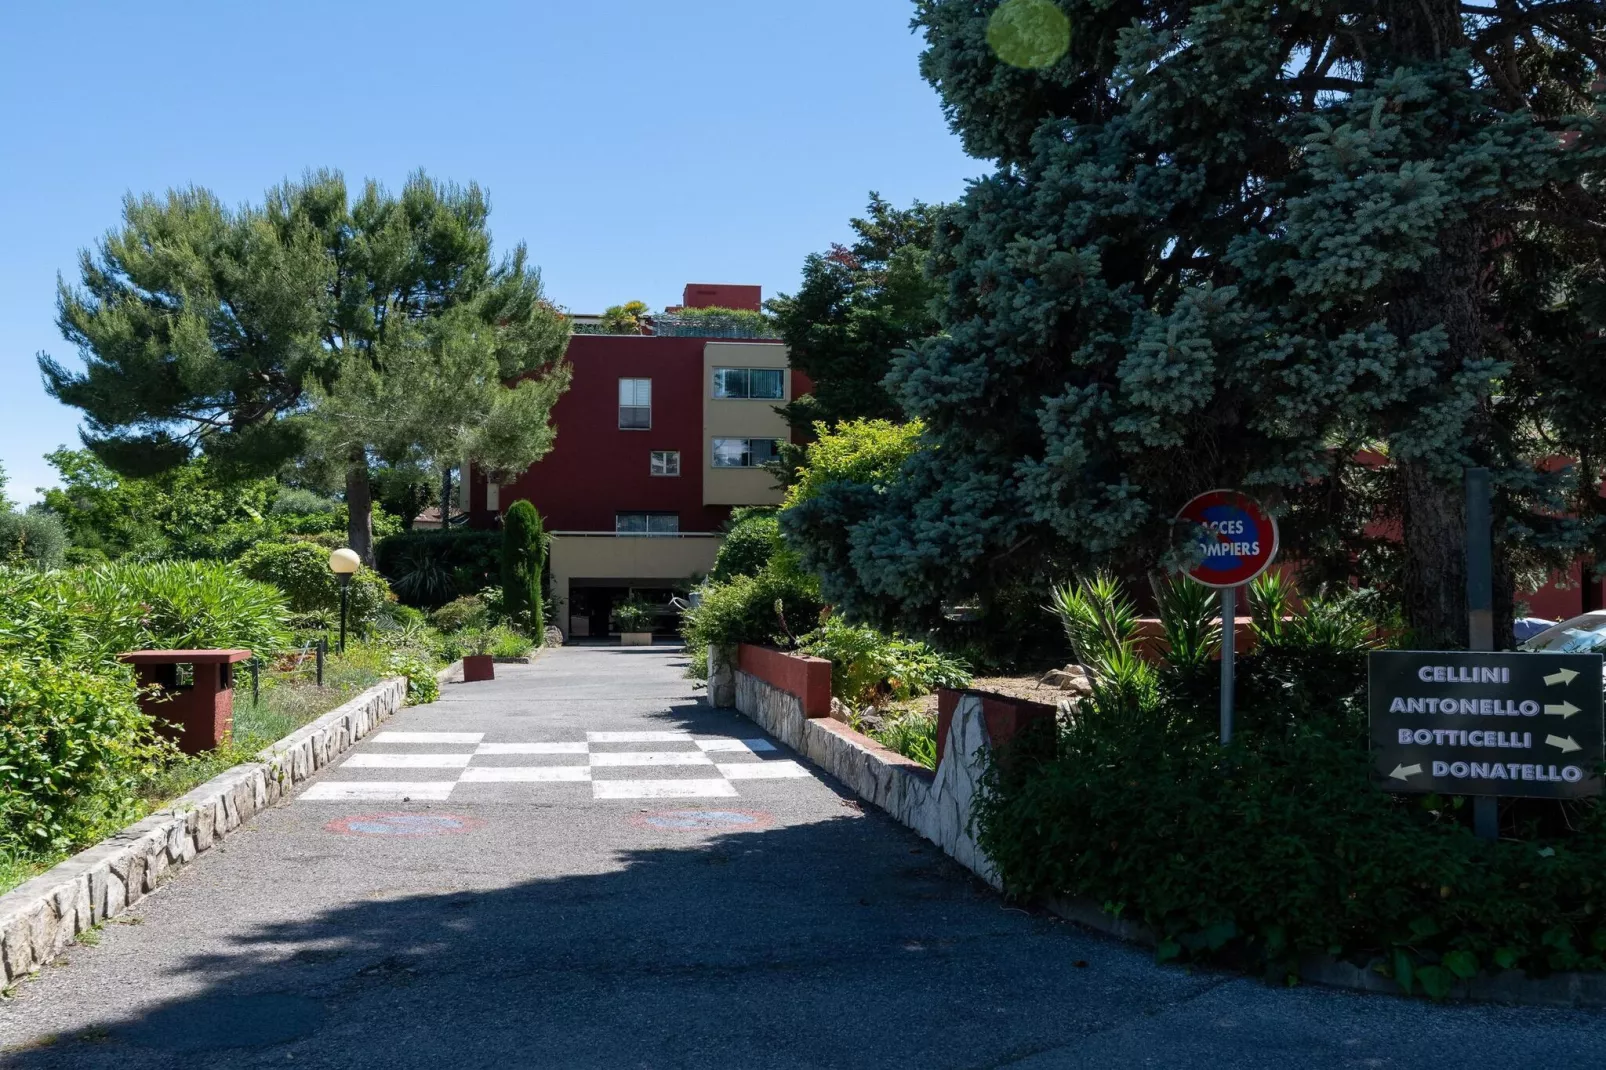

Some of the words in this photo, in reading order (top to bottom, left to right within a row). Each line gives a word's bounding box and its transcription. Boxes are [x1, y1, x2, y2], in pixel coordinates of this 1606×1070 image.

[1198, 541, 1260, 557] OMPIERS
[1418, 666, 1510, 684] CELLINI
[1389, 697, 1540, 717] ANTONELLO
[1398, 728, 1532, 748] BOTTICELLI
[1432, 761, 1583, 783] DONATELLO
